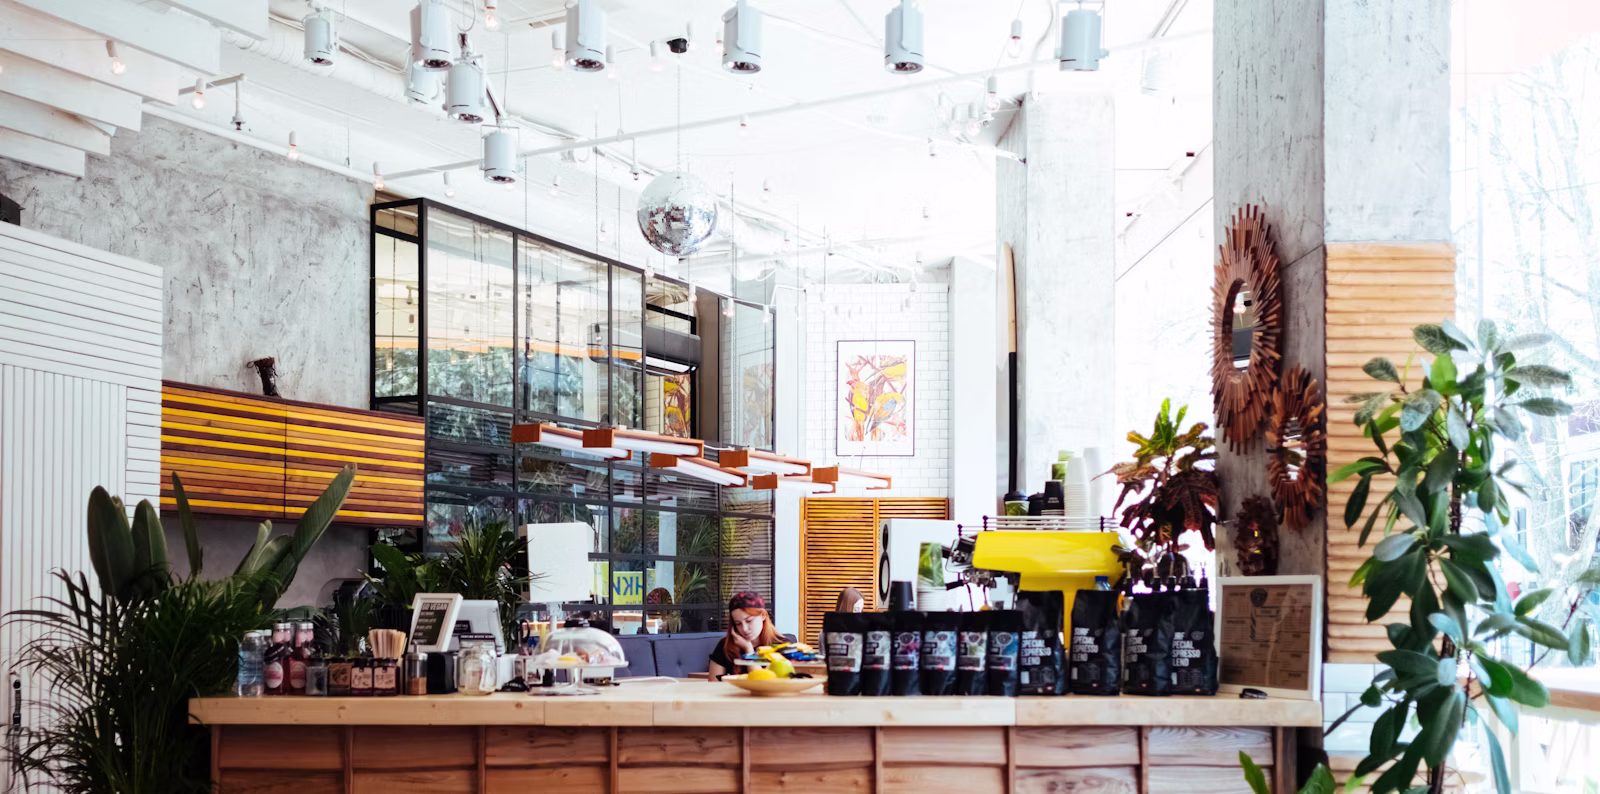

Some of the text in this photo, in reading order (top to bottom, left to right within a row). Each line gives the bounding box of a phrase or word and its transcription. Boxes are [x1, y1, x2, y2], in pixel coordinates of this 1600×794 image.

[430, 603, 449, 611] VEGAN
[1022, 631, 1037, 640] SURF
[1074, 627, 1090, 636] SURF
[1021, 639, 1045, 648] SPECIAL
[1073, 636, 1095, 645] SPECIAL
[1172, 640, 1194, 649] PECIAL
[1021, 647, 1051, 657] ESPRESSO
[1072, 644, 1099, 653] ESPRESSO
[1172, 649, 1201, 658] SPRESSO
[1172, 658, 1189, 667] LEND
